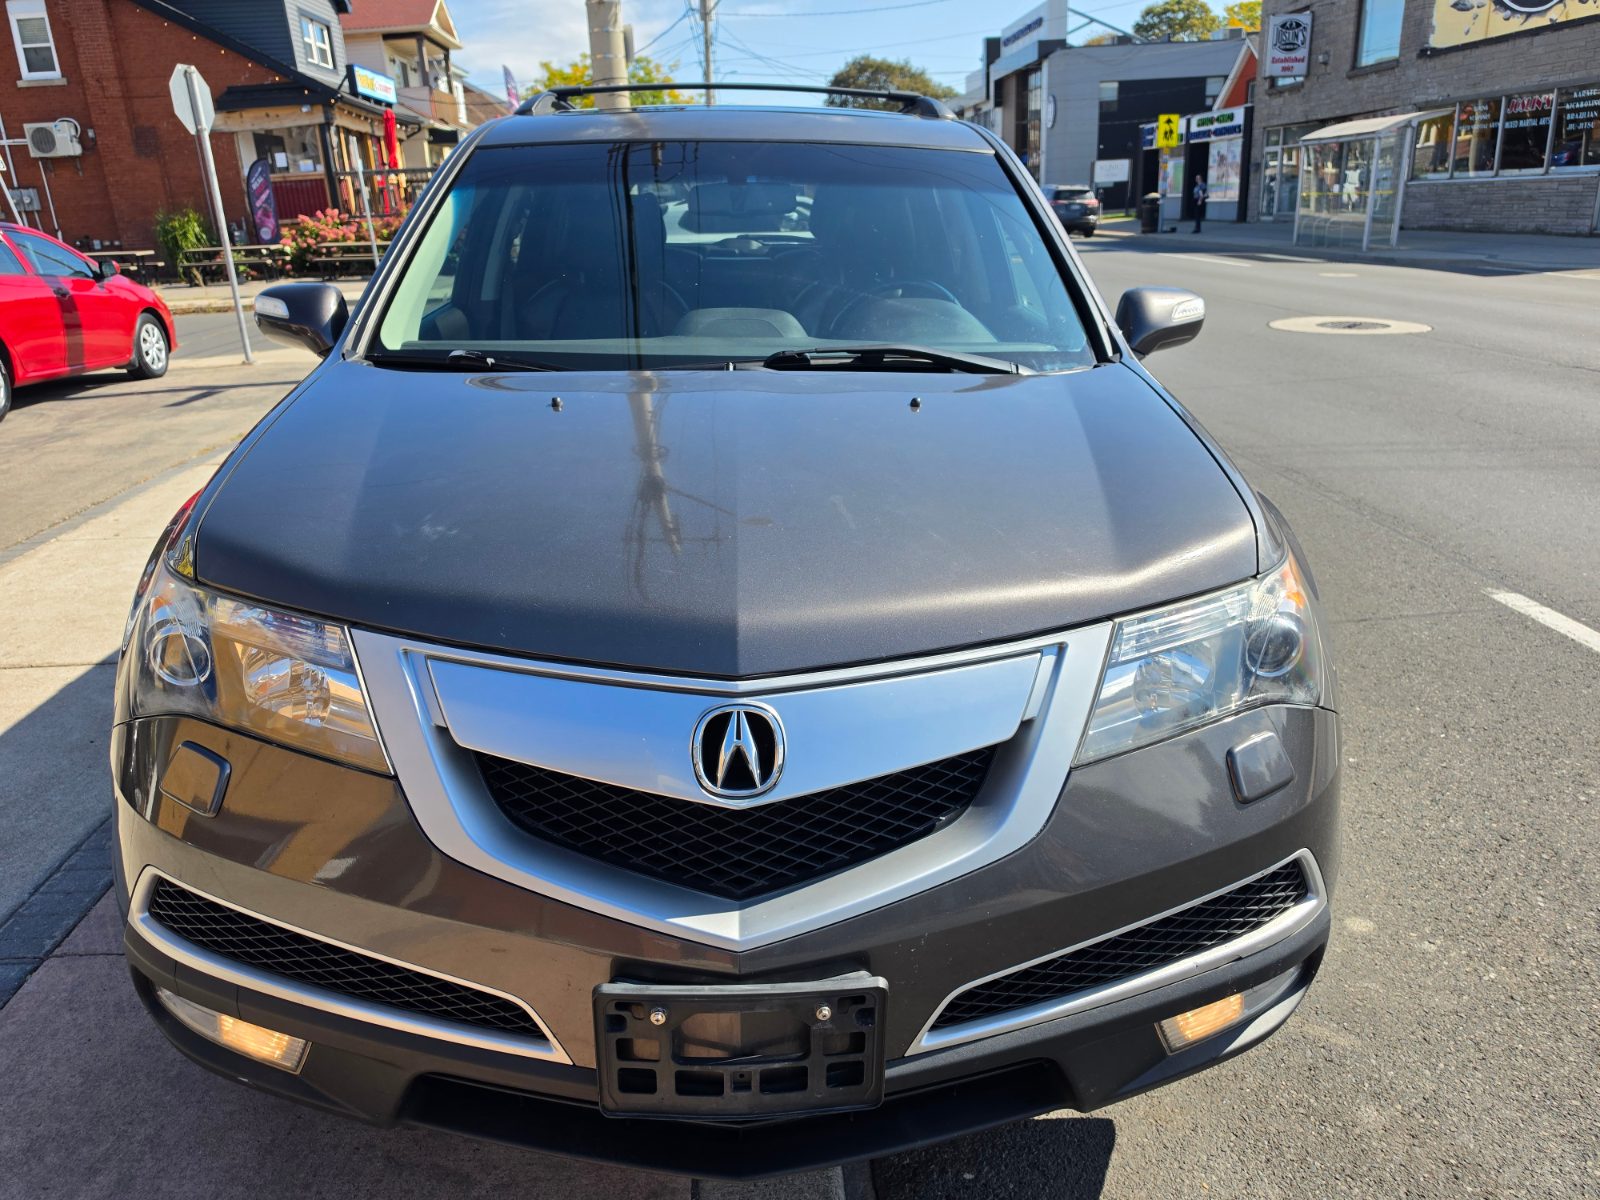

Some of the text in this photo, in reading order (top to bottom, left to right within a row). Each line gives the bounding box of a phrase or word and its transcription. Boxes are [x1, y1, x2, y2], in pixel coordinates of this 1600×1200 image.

[1272, 23, 1308, 46] JOSLIN'S
[1271, 55, 1305, 65] Established
[1566, 111, 1598, 120] BRAZILIAN
[1519, 118, 1538, 128] MARTIAL
